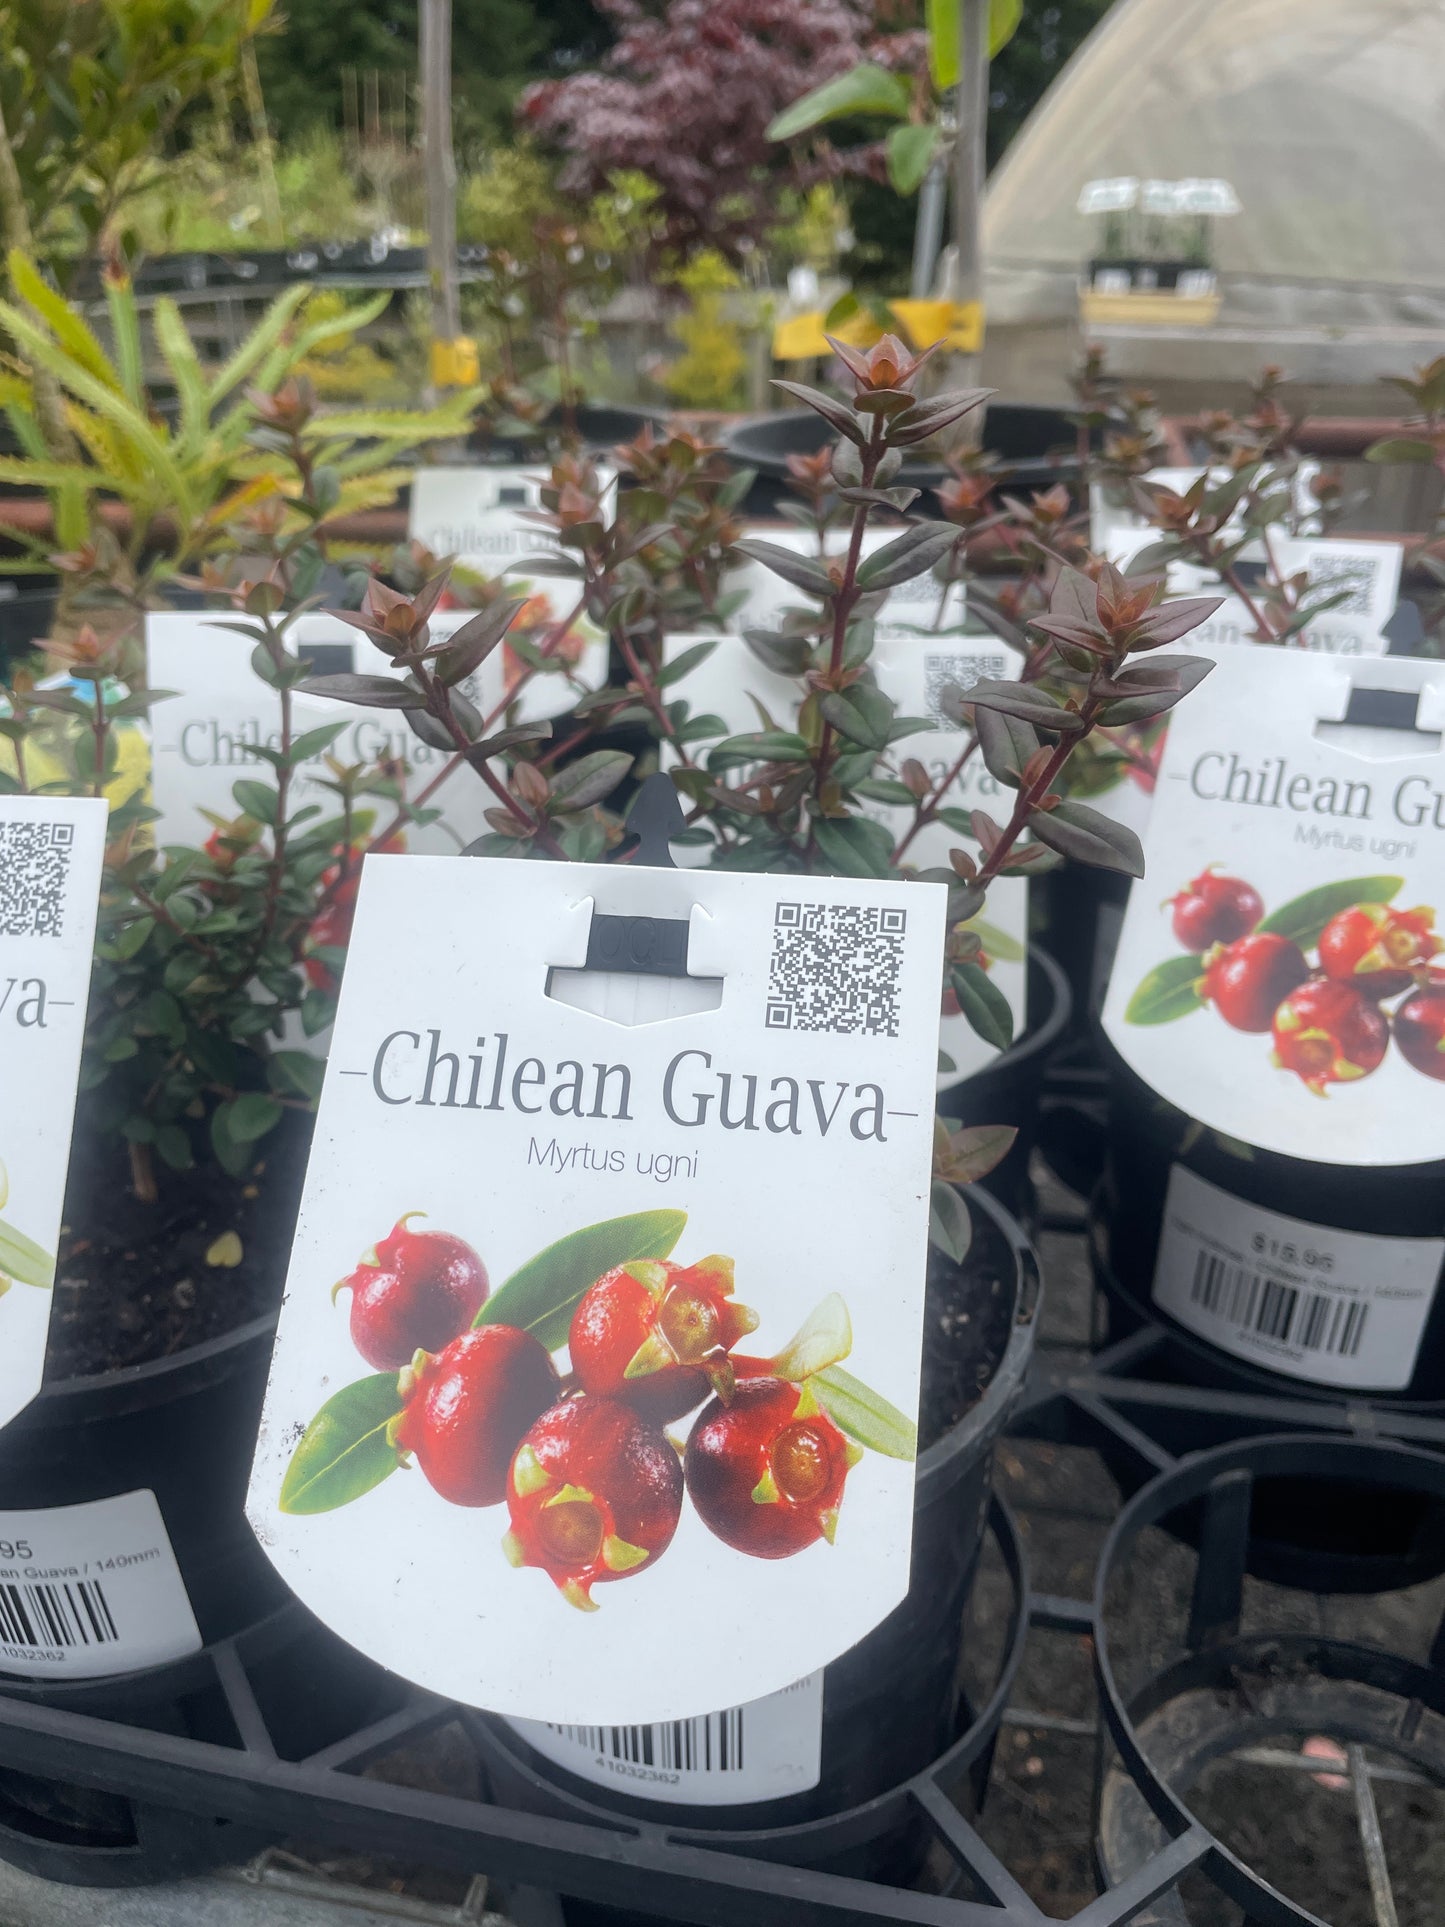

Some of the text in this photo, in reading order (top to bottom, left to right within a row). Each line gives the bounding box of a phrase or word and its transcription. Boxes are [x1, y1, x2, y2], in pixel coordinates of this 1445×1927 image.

[1190, 750, 1373, 821] Chilean
[1294, 822, 1417, 861] Myrtus ugni
[372, 1029, 888, 1143] Chilean Guava
[527, 1136, 698, 1182] Myrtus ugni
[24, 1565, 79, 1581] Guava
[96, 1547, 161, 1573] 140mm
[595, 1756, 681, 1785] 41032362
